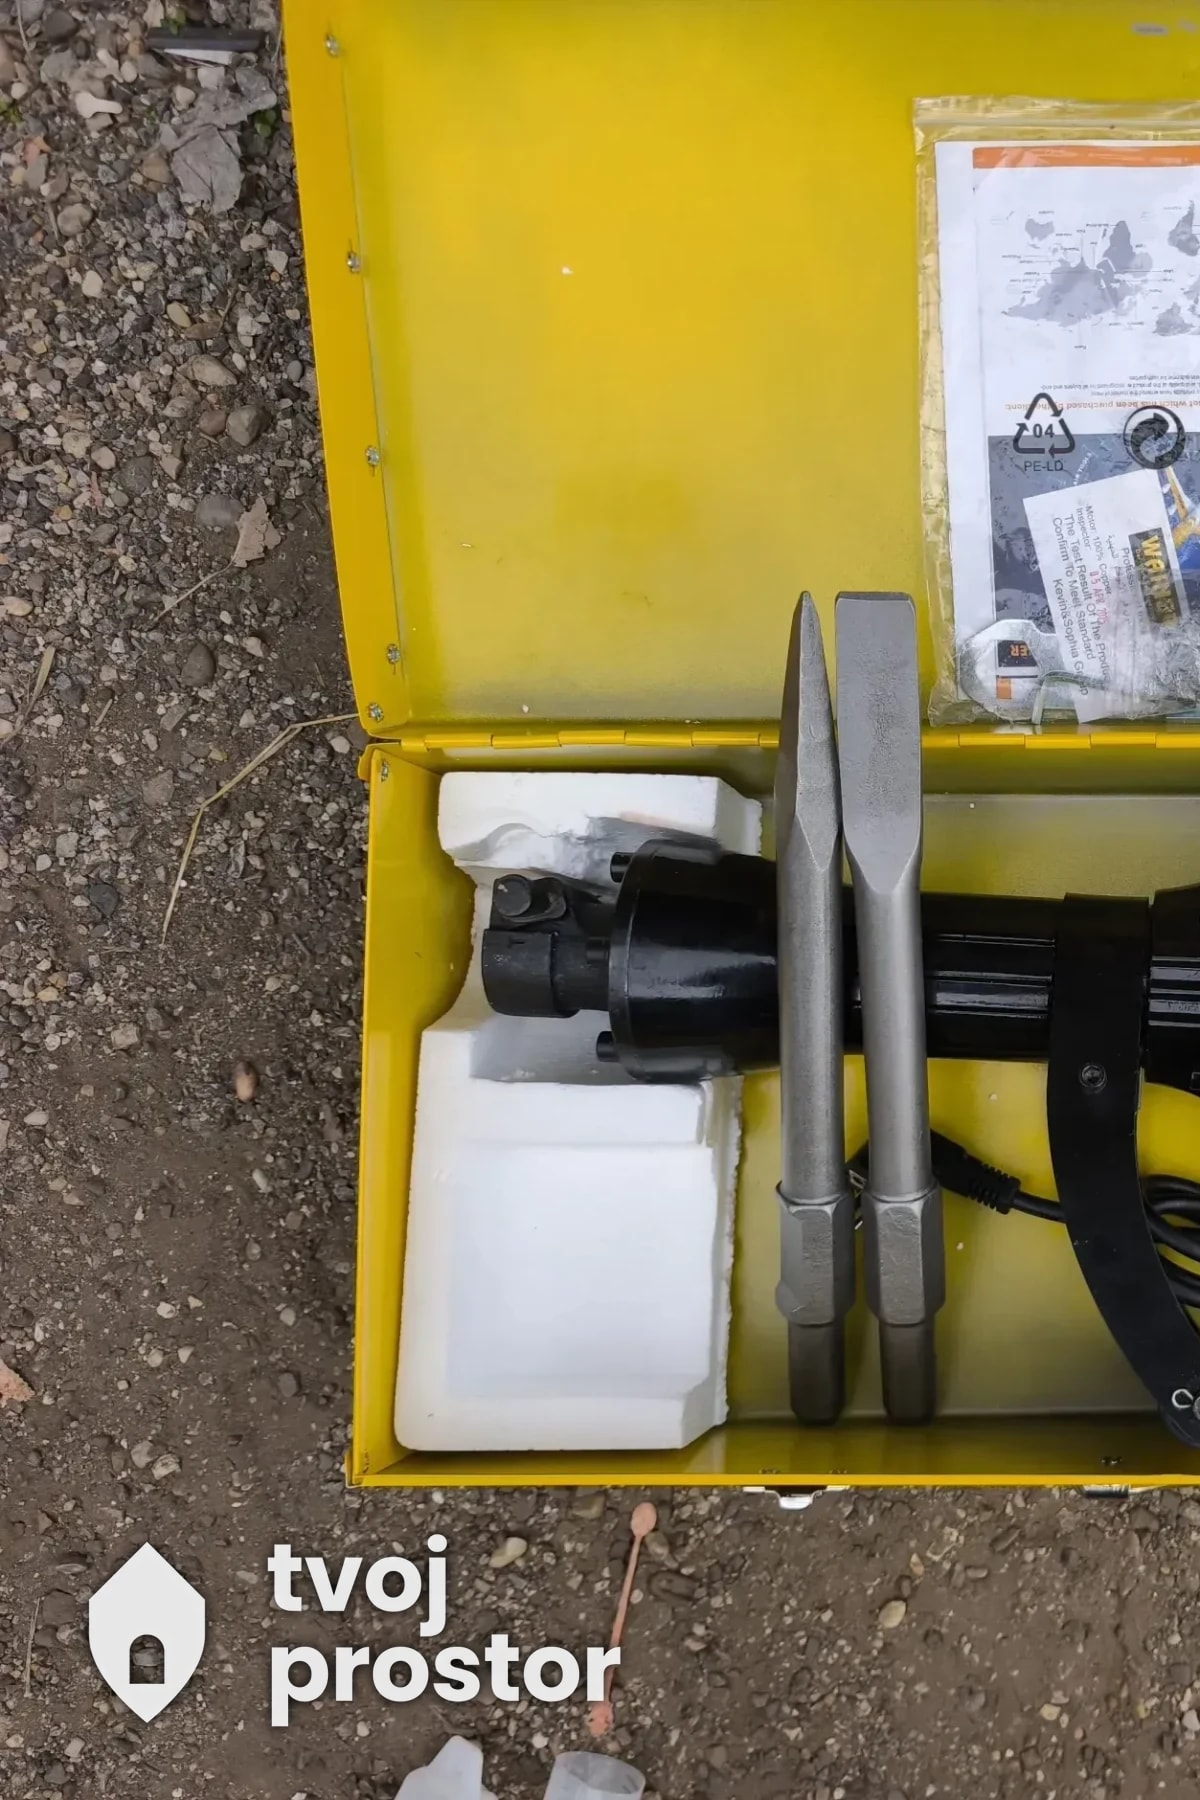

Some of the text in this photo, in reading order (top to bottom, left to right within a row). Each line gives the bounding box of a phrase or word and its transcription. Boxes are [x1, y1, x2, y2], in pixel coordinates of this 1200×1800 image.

[1066, 401, 1114, 410] purchased
[1033, 423, 1055, 438] 04
[1024, 460, 1064, 471] PE-LD
[1093, 536, 1104, 561] 100%
[1099, 563, 1112, 594] Copper
[1053, 517, 1096, 660] Confirm To Meet Standard
[1065, 513, 1111, 683] The Test Result Of The Produc
[1053, 579, 1079, 658] Kevin&Sophia
[1010, 644, 1030, 657] ER
